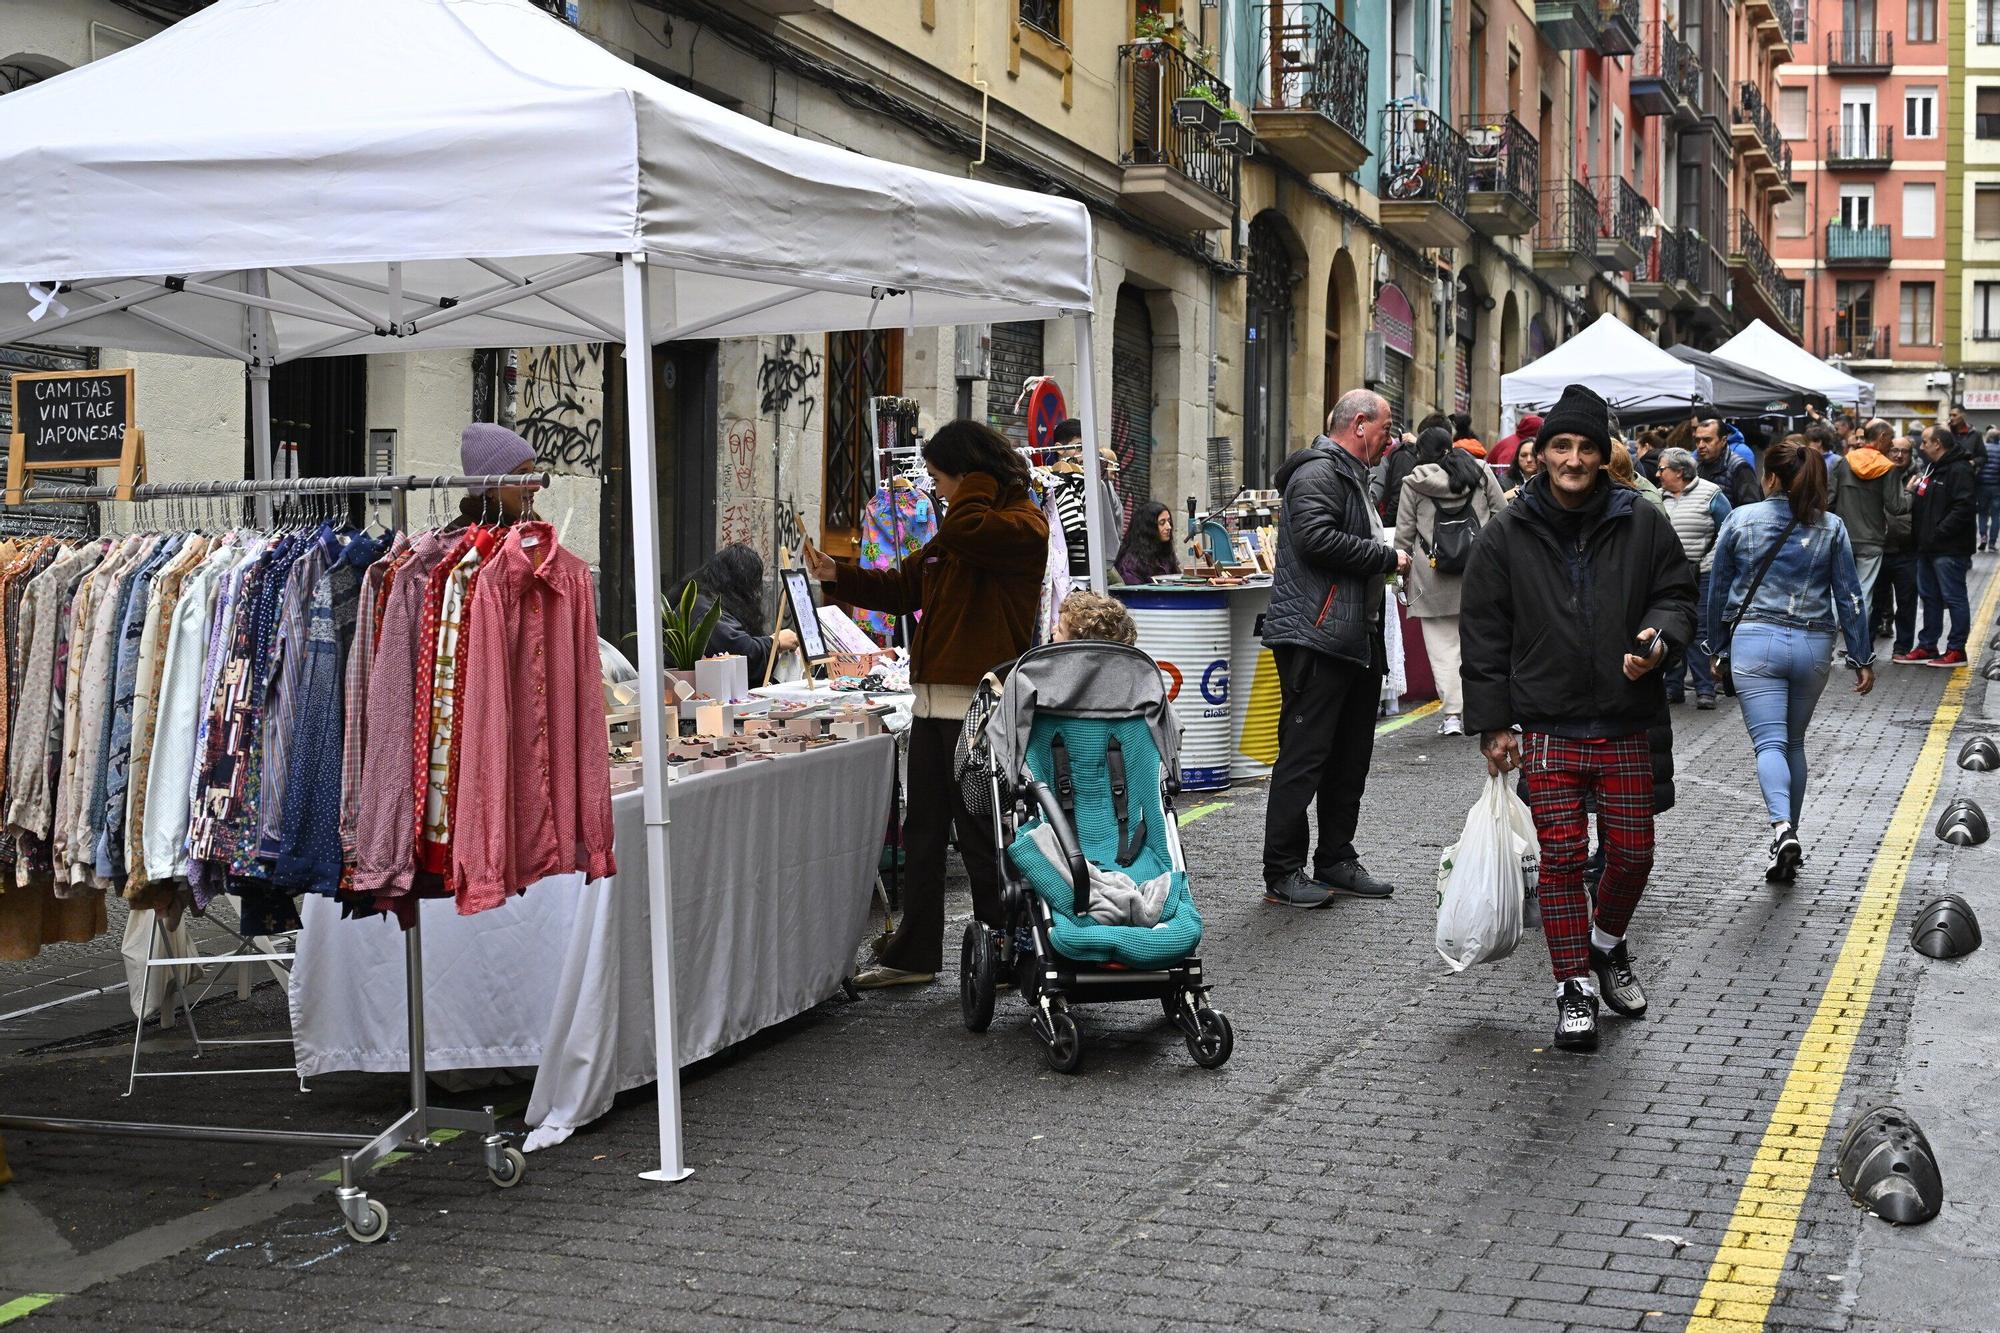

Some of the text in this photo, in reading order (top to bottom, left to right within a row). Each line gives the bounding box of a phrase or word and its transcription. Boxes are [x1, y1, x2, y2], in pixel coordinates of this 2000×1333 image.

[35, 381, 112, 400] CAMISAS
[39, 401, 115, 421] VINTAGE
[36, 423, 126, 446] JAPONESAS
